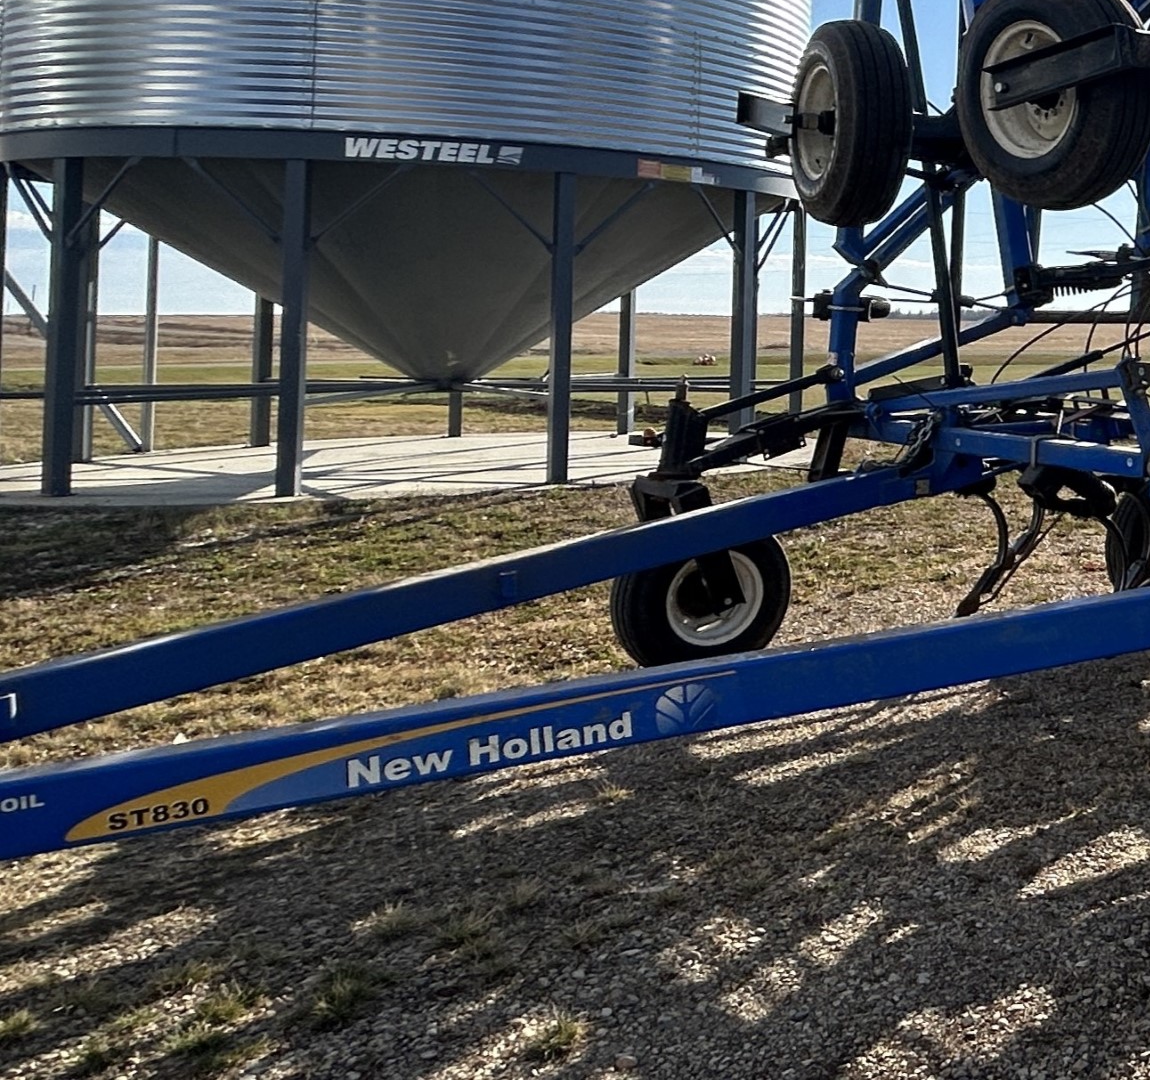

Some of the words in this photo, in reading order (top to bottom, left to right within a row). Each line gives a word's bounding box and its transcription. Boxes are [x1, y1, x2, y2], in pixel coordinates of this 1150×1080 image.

[344, 137, 494, 164] WESTEEL
[346, 749, 453, 788] New
[468, 711, 633, 766] Holland
[108, 797, 209, 831] ST830
